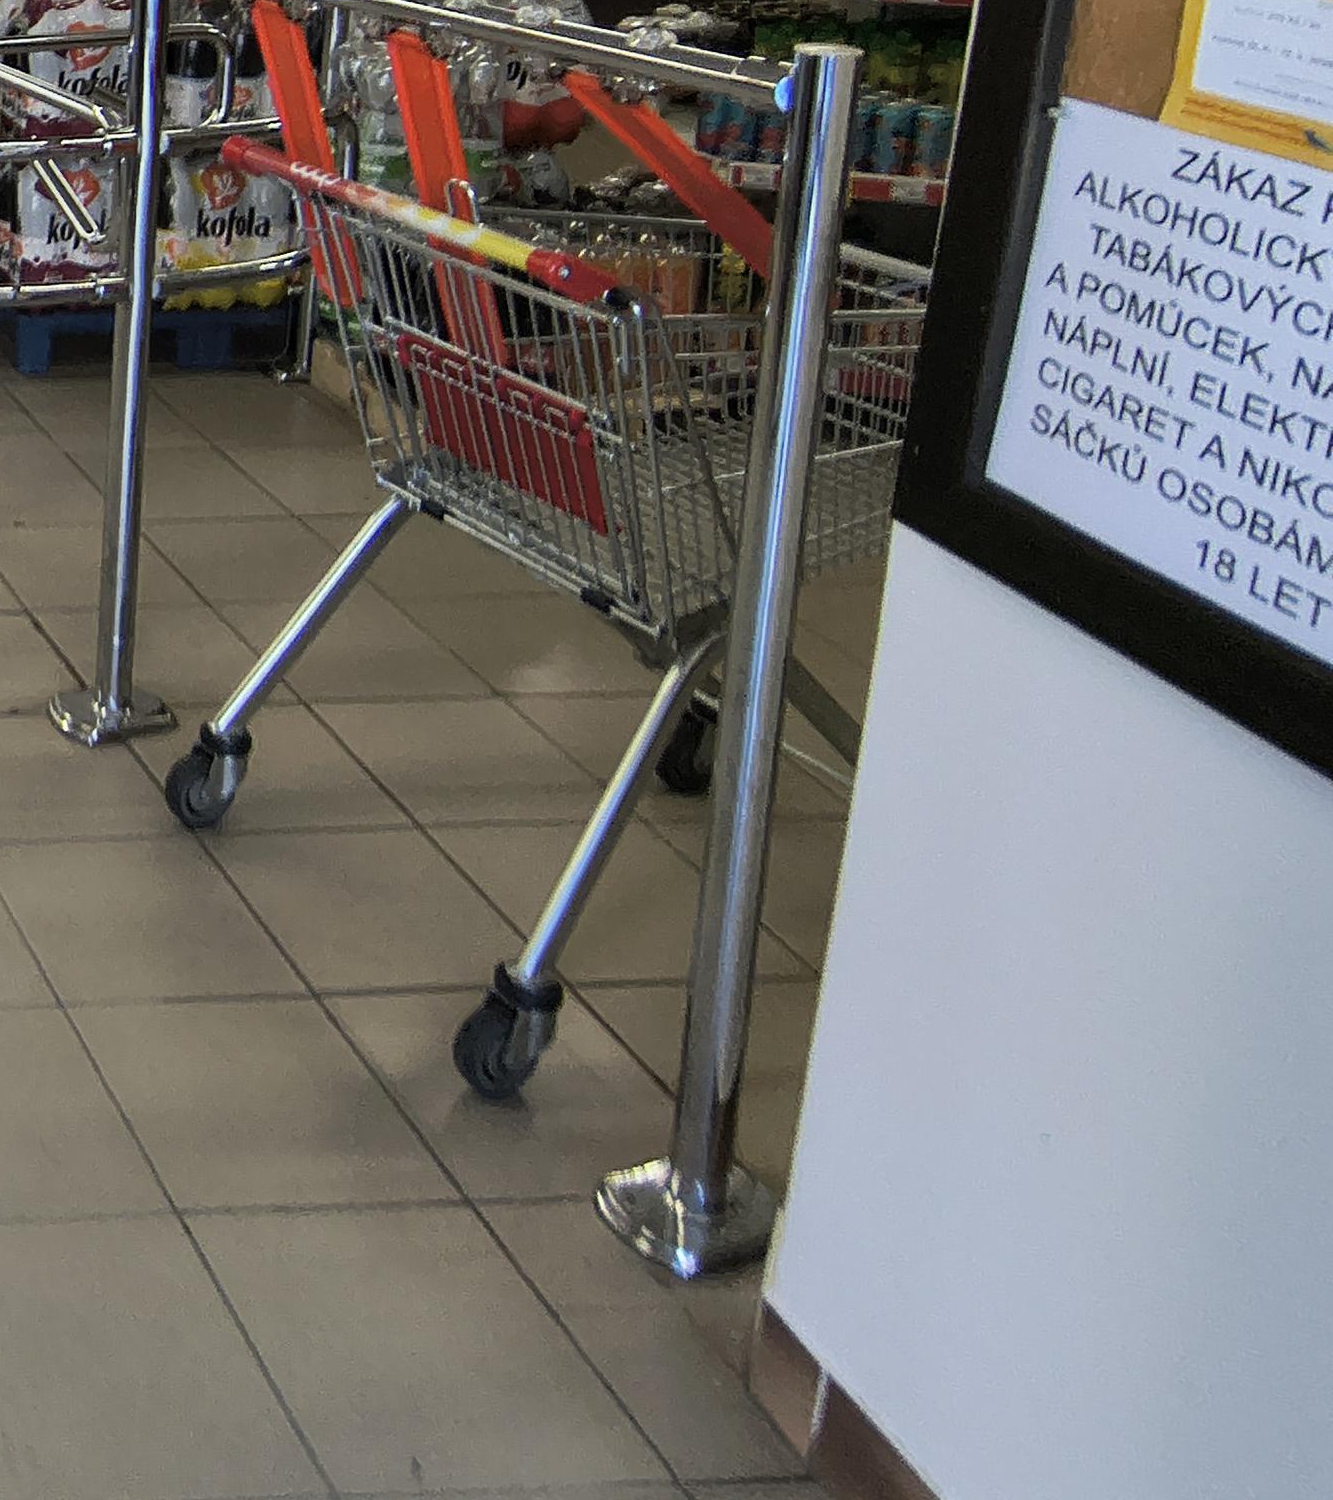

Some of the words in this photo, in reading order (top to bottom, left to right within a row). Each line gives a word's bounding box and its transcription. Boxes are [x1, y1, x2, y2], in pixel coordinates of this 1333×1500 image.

[196, 207, 270, 248] kofola
[1074, 170, 1333, 282] ALKOHOLICK
[1171, 149, 1313, 217] ZÁKAZ
[1044, 308, 1173, 396] NÁPLNÍ,
[1045, 262, 1068, 294] A
[1077, 271, 1274, 383] POMŮCEK,
[1031, 404, 1146, 483] SÁČKŮ
[1038, 356, 1195, 450] CIGARET
[1199, 434, 1226, 469] A
[1197, 539, 1235, 582] 18
[1248, 564, 1332, 629] LET
